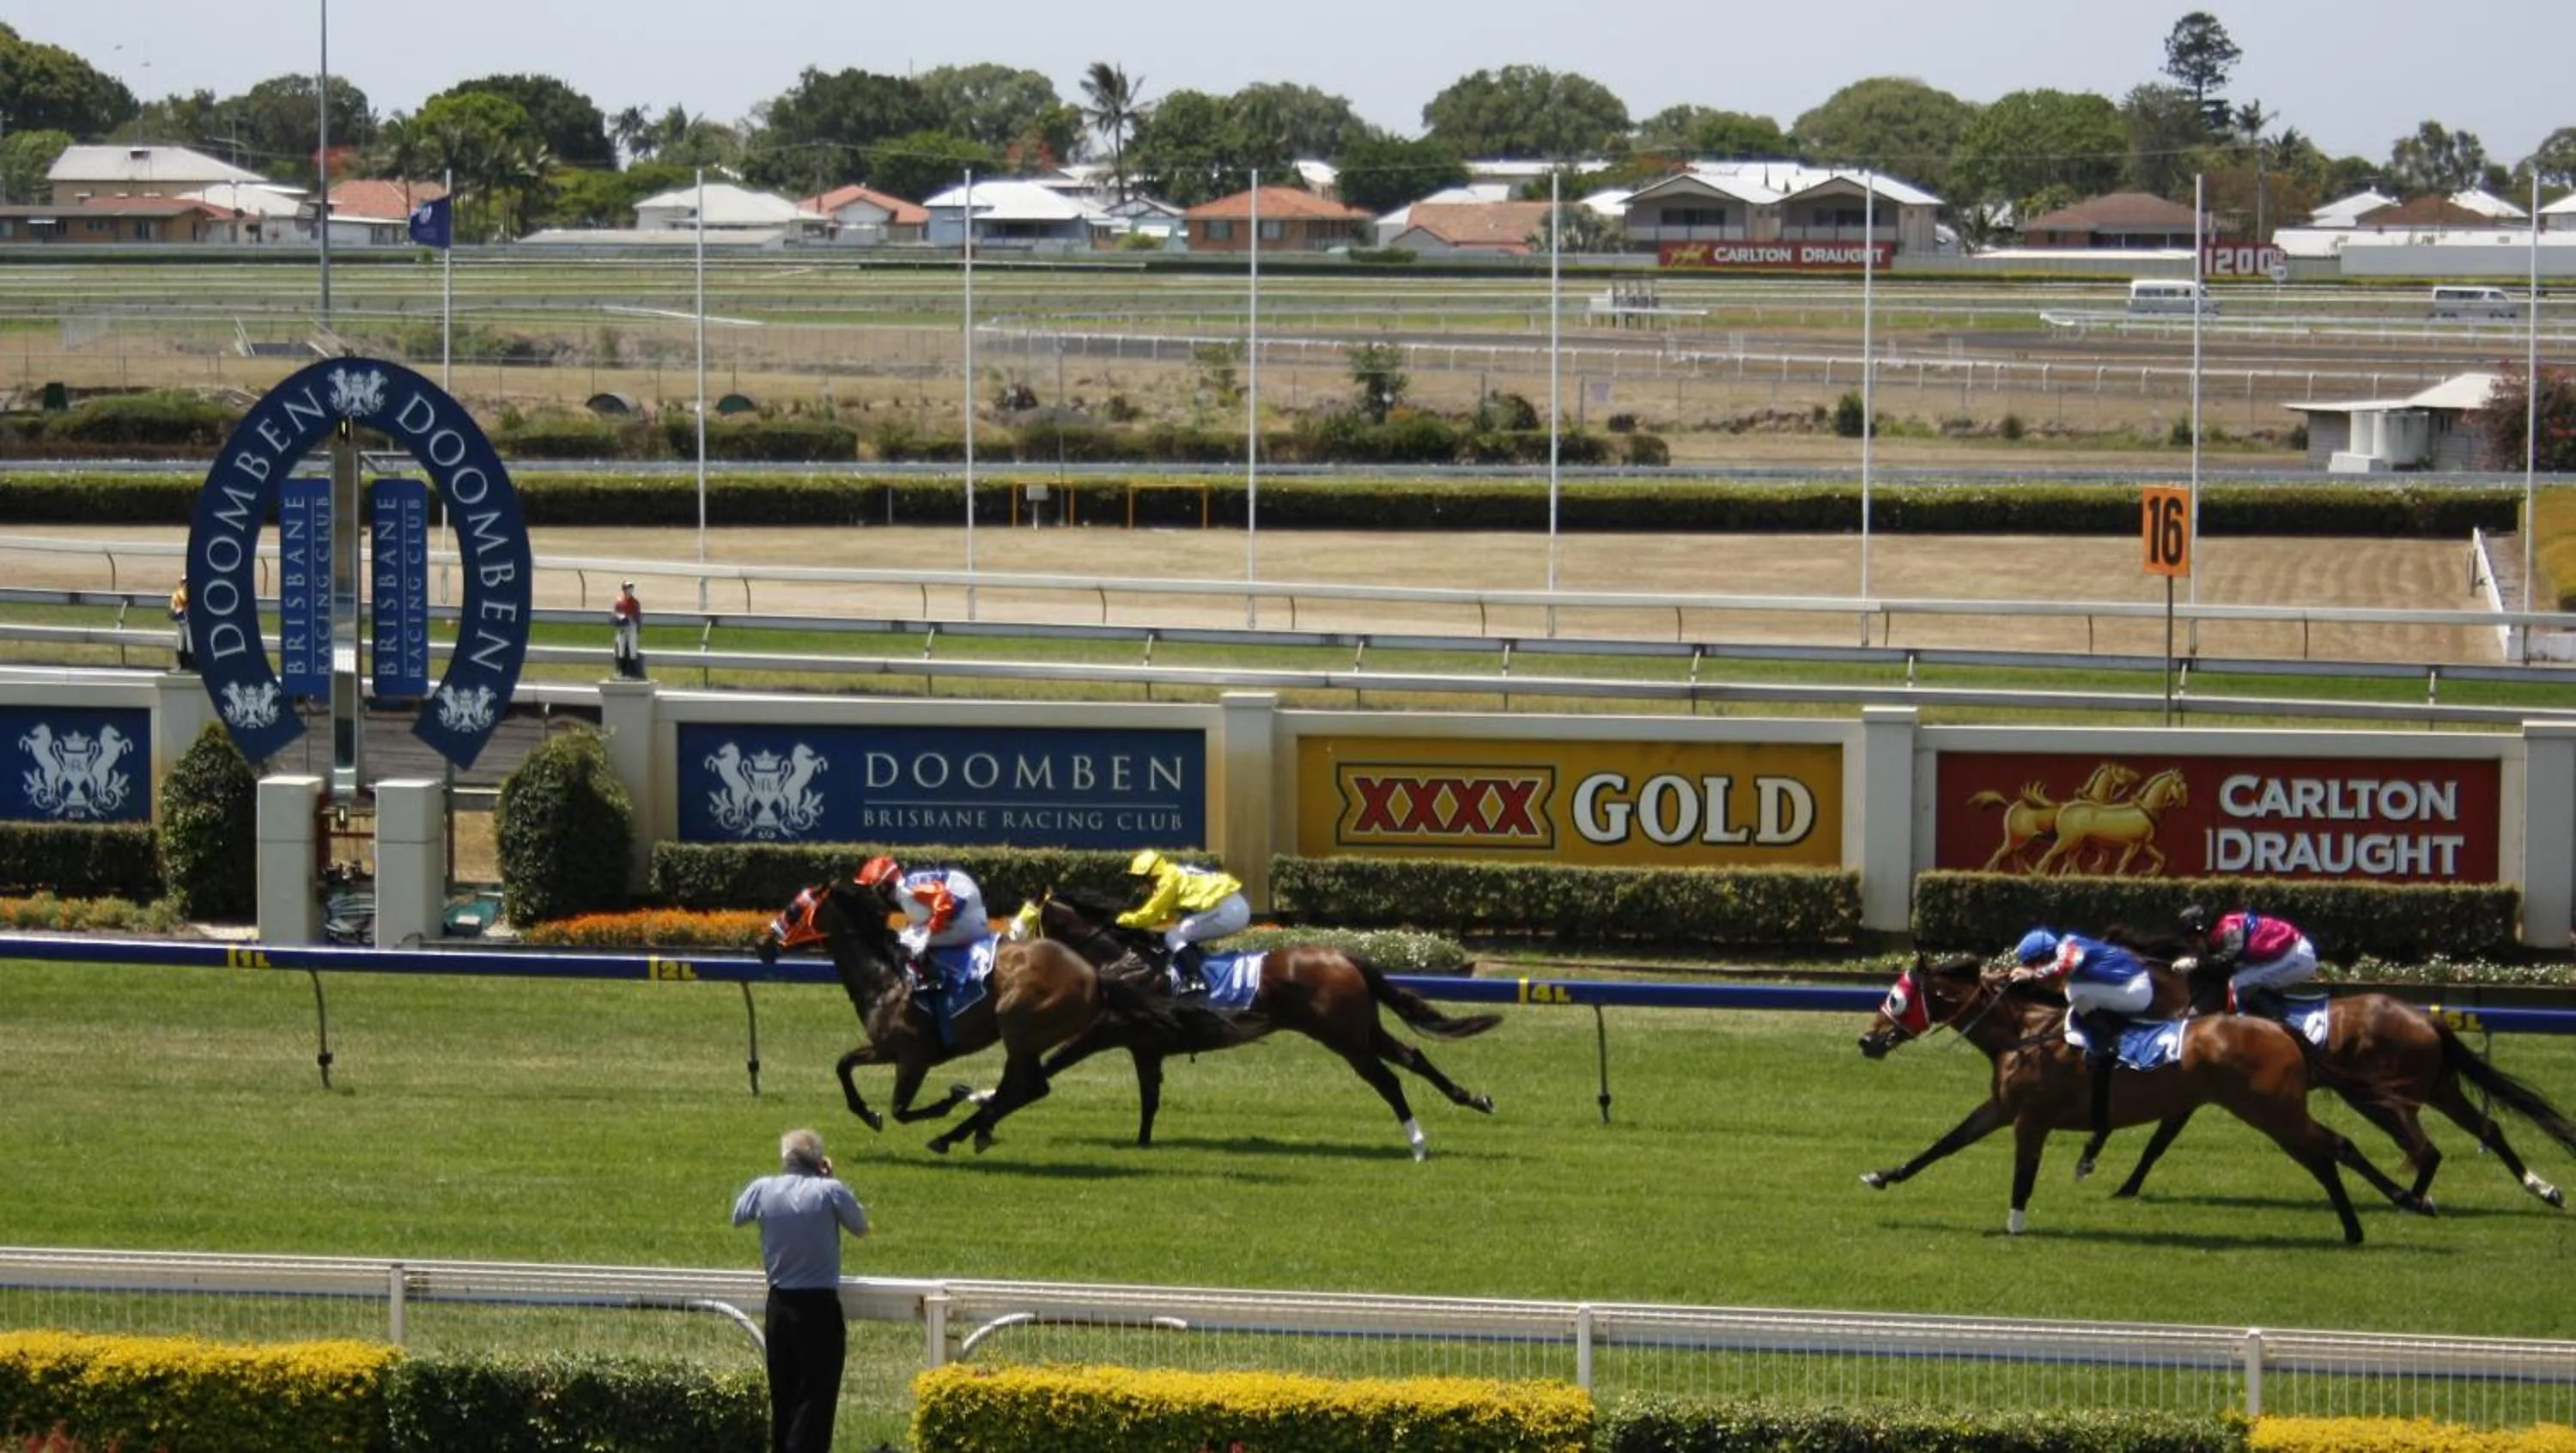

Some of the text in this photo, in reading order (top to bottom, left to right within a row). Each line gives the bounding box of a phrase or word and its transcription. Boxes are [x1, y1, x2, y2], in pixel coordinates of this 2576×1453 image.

[1714, 247, 1791, 263] CARLTON
[2205, 247, 2274, 274] 1200
[204, 387, 325, 660] DOOMBEN
[396, 393, 516, 673] DOOMBEN
[2148, 495, 2183, 566] 16
[285, 497, 306, 674] BRISBANE
[316, 496, 331, 674] RACING CLUB
[377, 498, 398, 675] BRISBANE
[408, 499, 422, 678] RACING CLUB
[865, 752, 1183, 792] DOOMBEN
[2219, 775, 2458, 822] CARLTON
[864, 809, 1183, 832] BRISBANE RACING CLUB
[1350, 772, 1815, 846] XXXX GOLD
[2205, 827, 2464, 876] DRAUGHT
